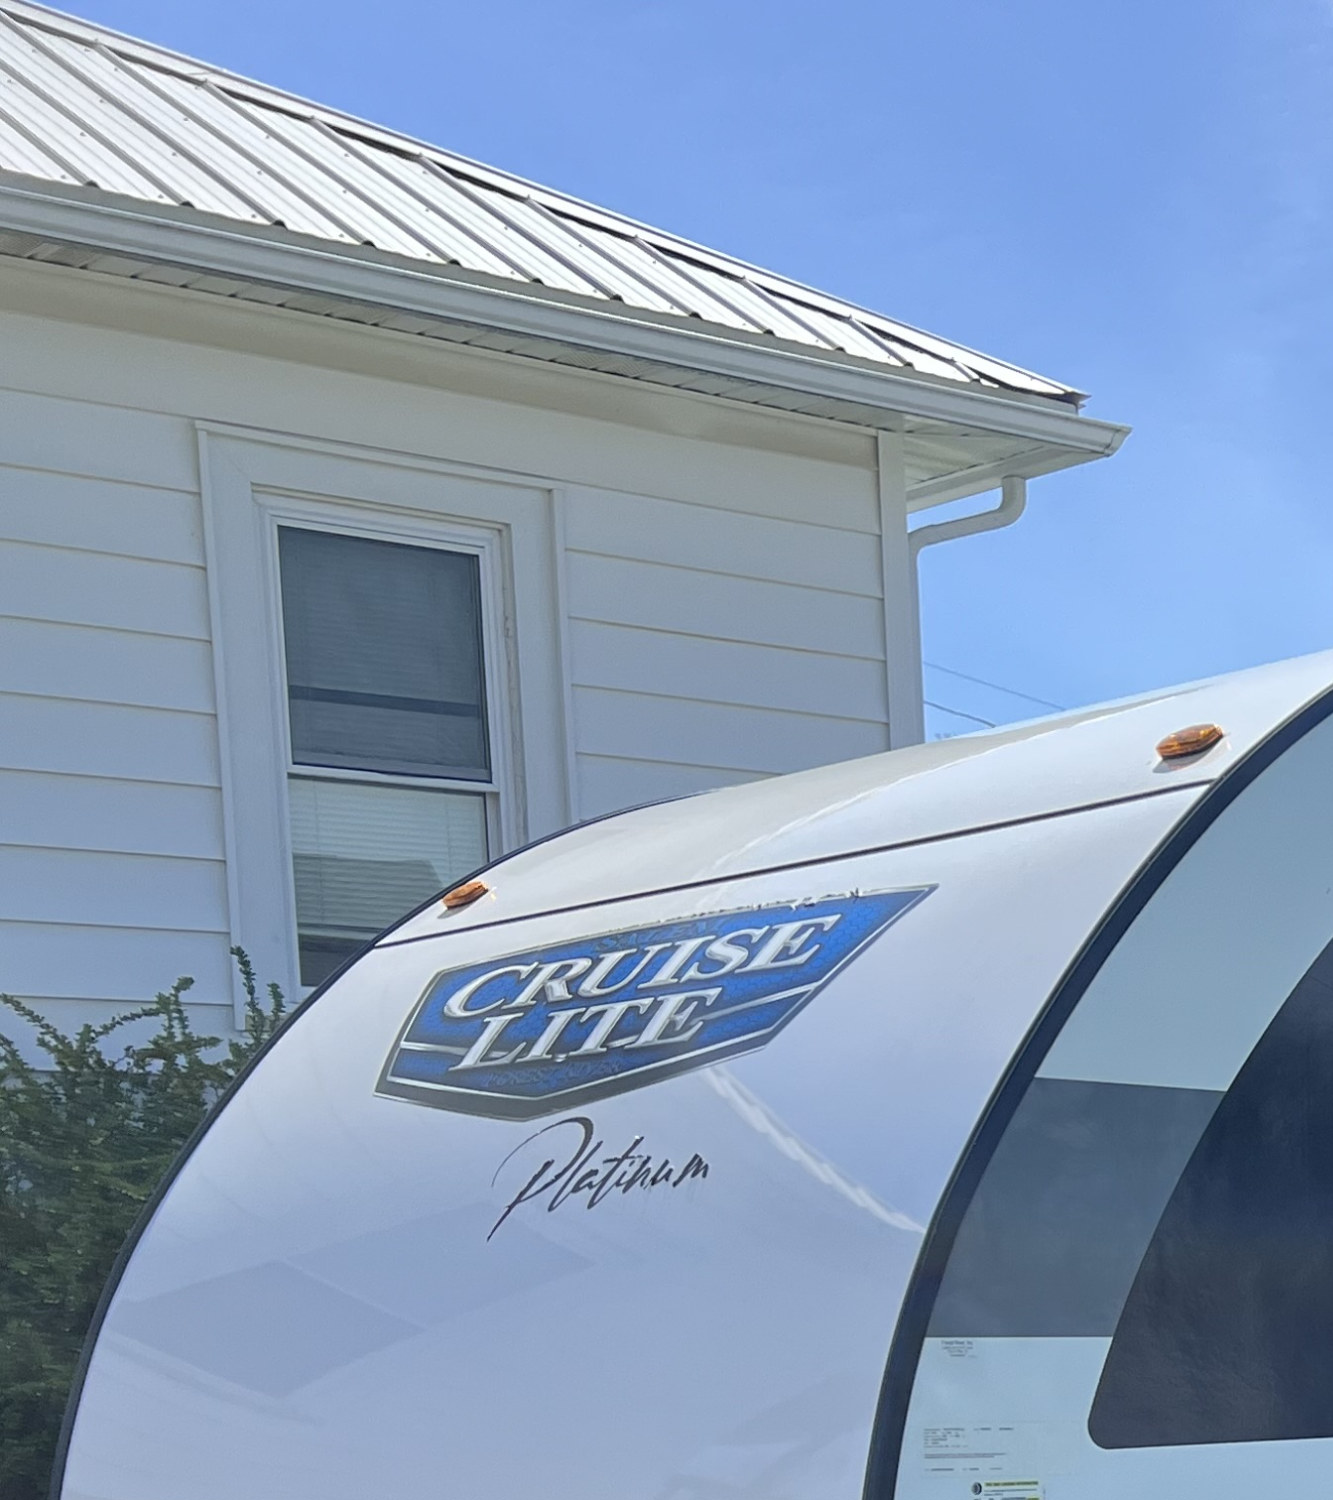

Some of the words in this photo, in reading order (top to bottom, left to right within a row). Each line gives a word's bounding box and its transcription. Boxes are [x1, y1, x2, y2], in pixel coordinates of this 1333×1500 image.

[443, 914, 841, 1018] CRUISE
[449, 987, 725, 1071] LITE
[486, 1117, 709, 1242] Platinum
